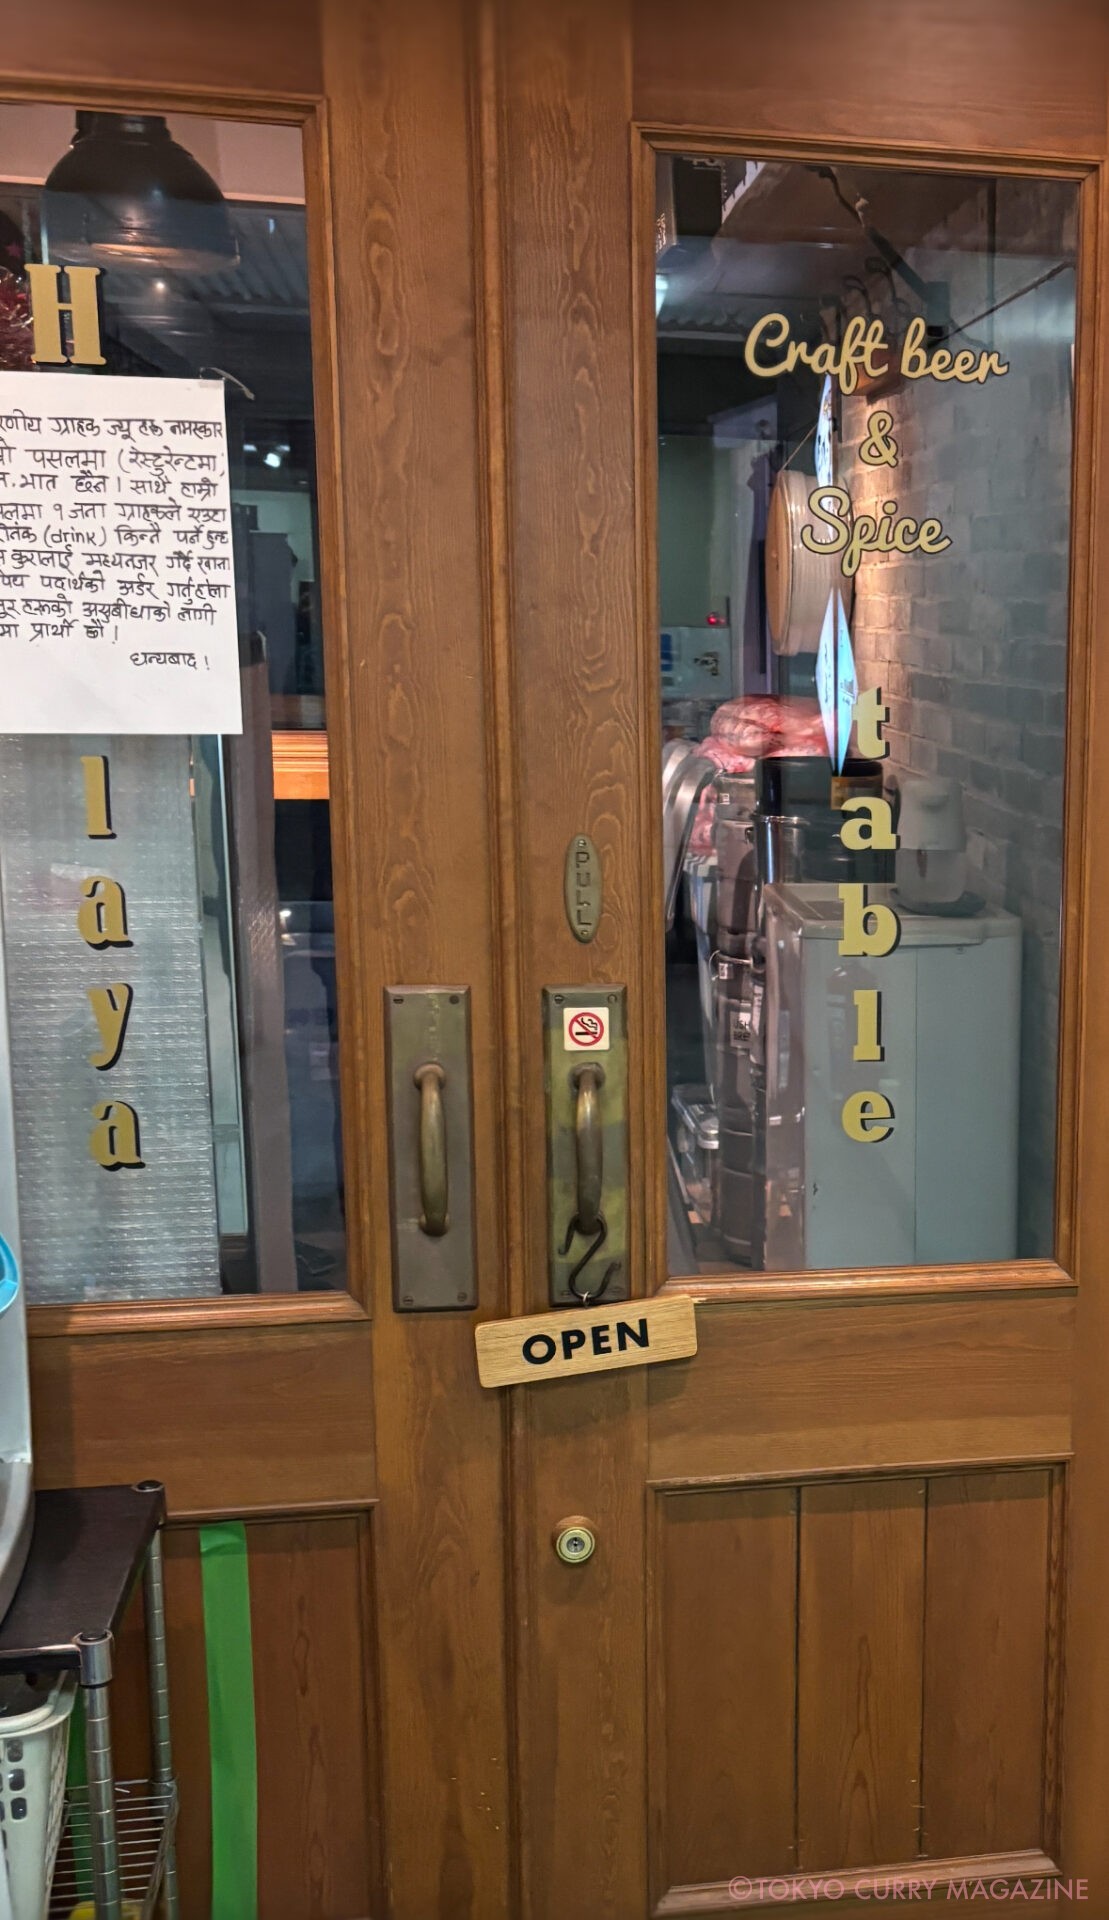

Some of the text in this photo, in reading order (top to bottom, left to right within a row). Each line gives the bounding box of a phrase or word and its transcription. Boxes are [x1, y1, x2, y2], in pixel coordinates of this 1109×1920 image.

[744, 312, 1009, 396] Craft beer
[24, 449, 107, 470] पसलमा
[858, 410, 899, 468] &
[43, 524, 107, 548] (drink)
[800, 485, 953, 578] Spice
[575, 850, 593, 927] PULL
[838, 685, 903, 1146] table
[522, 1317, 650, 1365] OPEN
